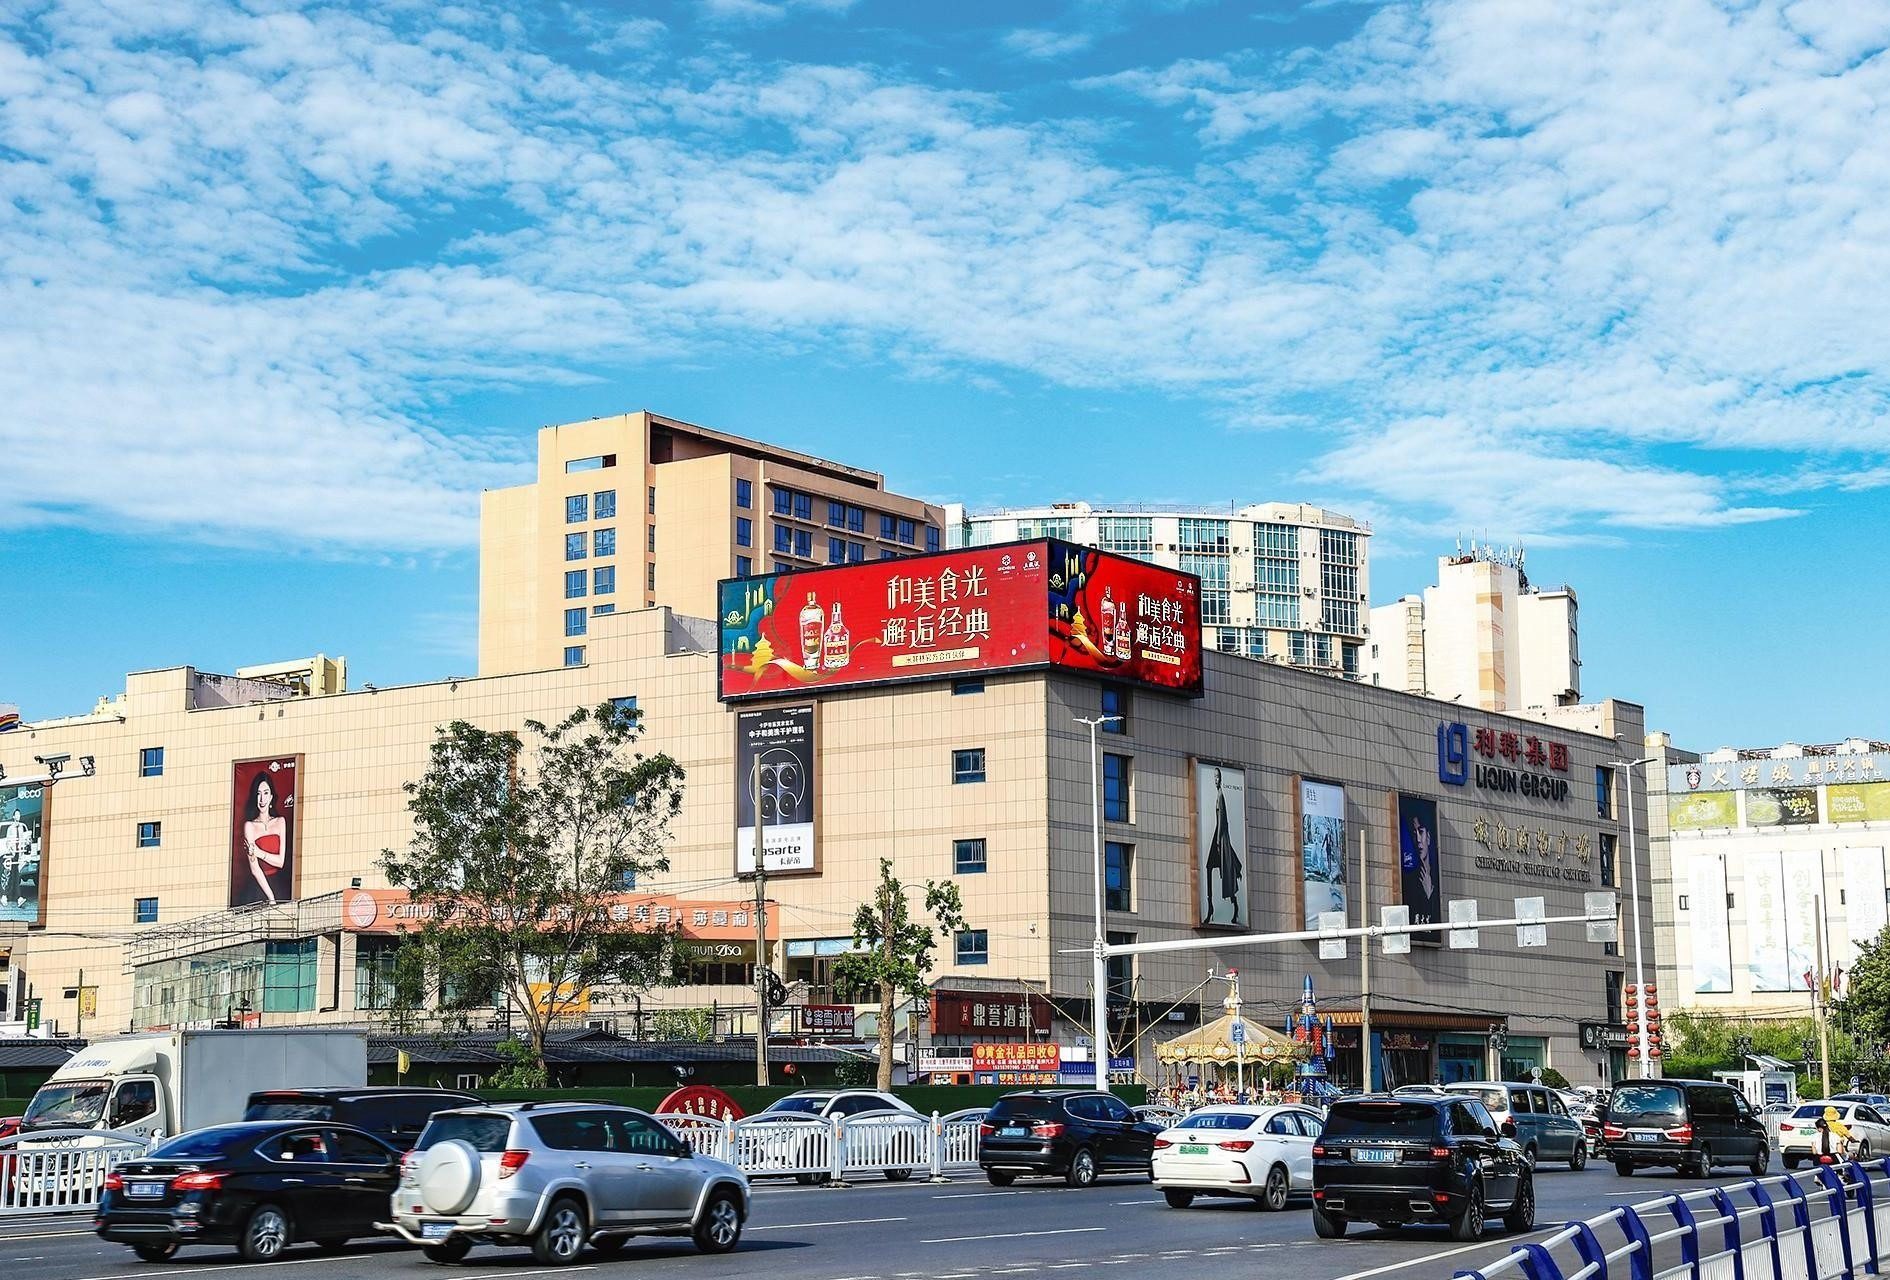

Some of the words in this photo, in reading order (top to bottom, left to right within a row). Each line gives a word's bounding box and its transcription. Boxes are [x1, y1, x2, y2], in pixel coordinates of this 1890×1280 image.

[886, 564, 988, 612] 和美食光
[1138, 593, 1184, 624] 和美食光
[881, 606, 991, 648] 邂逅经典
[1136, 622, 1186, 654] 邂逅经典
[1474, 728, 1568, 772] 利群集团
[1808, 757, 1874, 774] 重庆火锅
[1476, 765, 1517, 794] LIQUN
[1520, 773, 1568, 802] GROUP
[813, 1009, 853, 1026] 蜜雪冰城
[985, 1045, 1047, 1059] 黄金礼品回收
